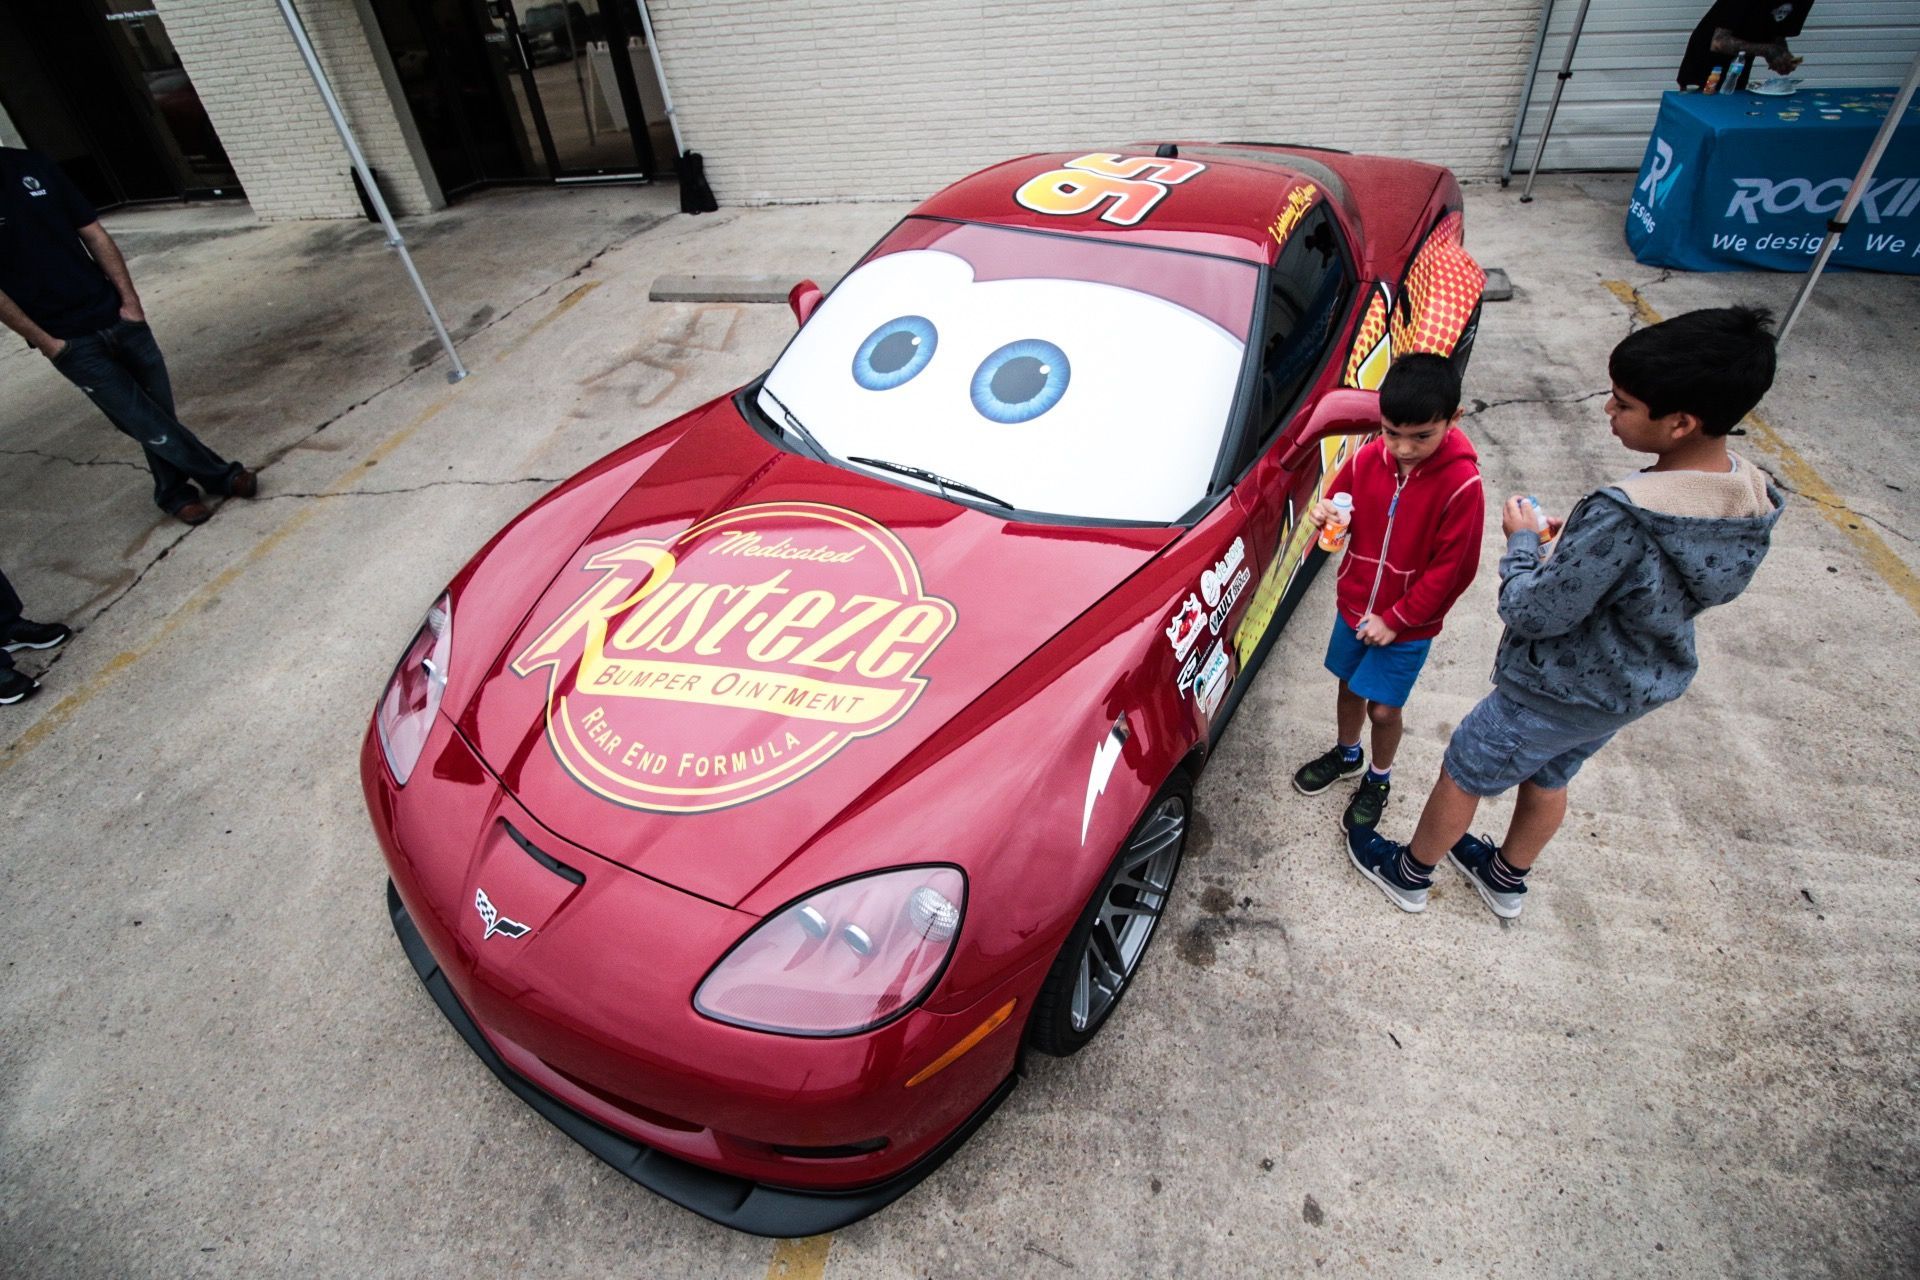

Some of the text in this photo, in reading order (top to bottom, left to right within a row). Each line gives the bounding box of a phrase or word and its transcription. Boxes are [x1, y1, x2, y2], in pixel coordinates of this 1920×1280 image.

[1711, 233, 1747, 252] We
[1866, 233, 1906, 253] We
[709, 530, 866, 564] Medicated
[1211, 588, 1235, 631] VAULT
[593, 664, 866, 715] BUMPER OINTMENT
[581, 705, 802, 778] REAR END FORMULA
